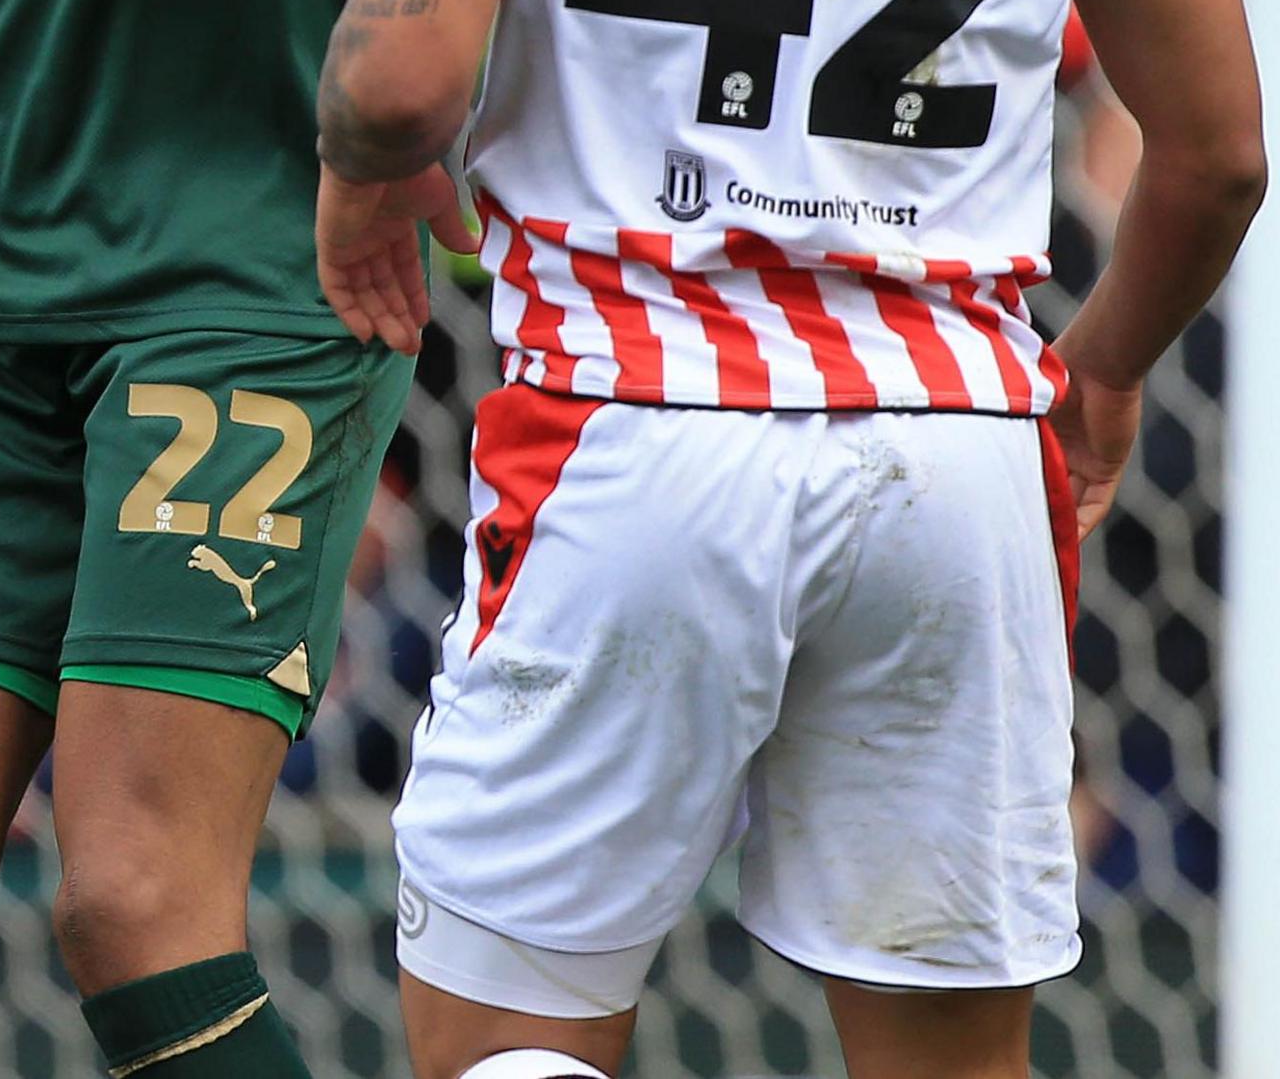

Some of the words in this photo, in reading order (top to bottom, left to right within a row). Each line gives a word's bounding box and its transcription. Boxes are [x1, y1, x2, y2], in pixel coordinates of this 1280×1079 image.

[721, 101, 749, 119] EFL
[892, 121, 917, 139] EFL
[118, 383, 314, 550] 22
